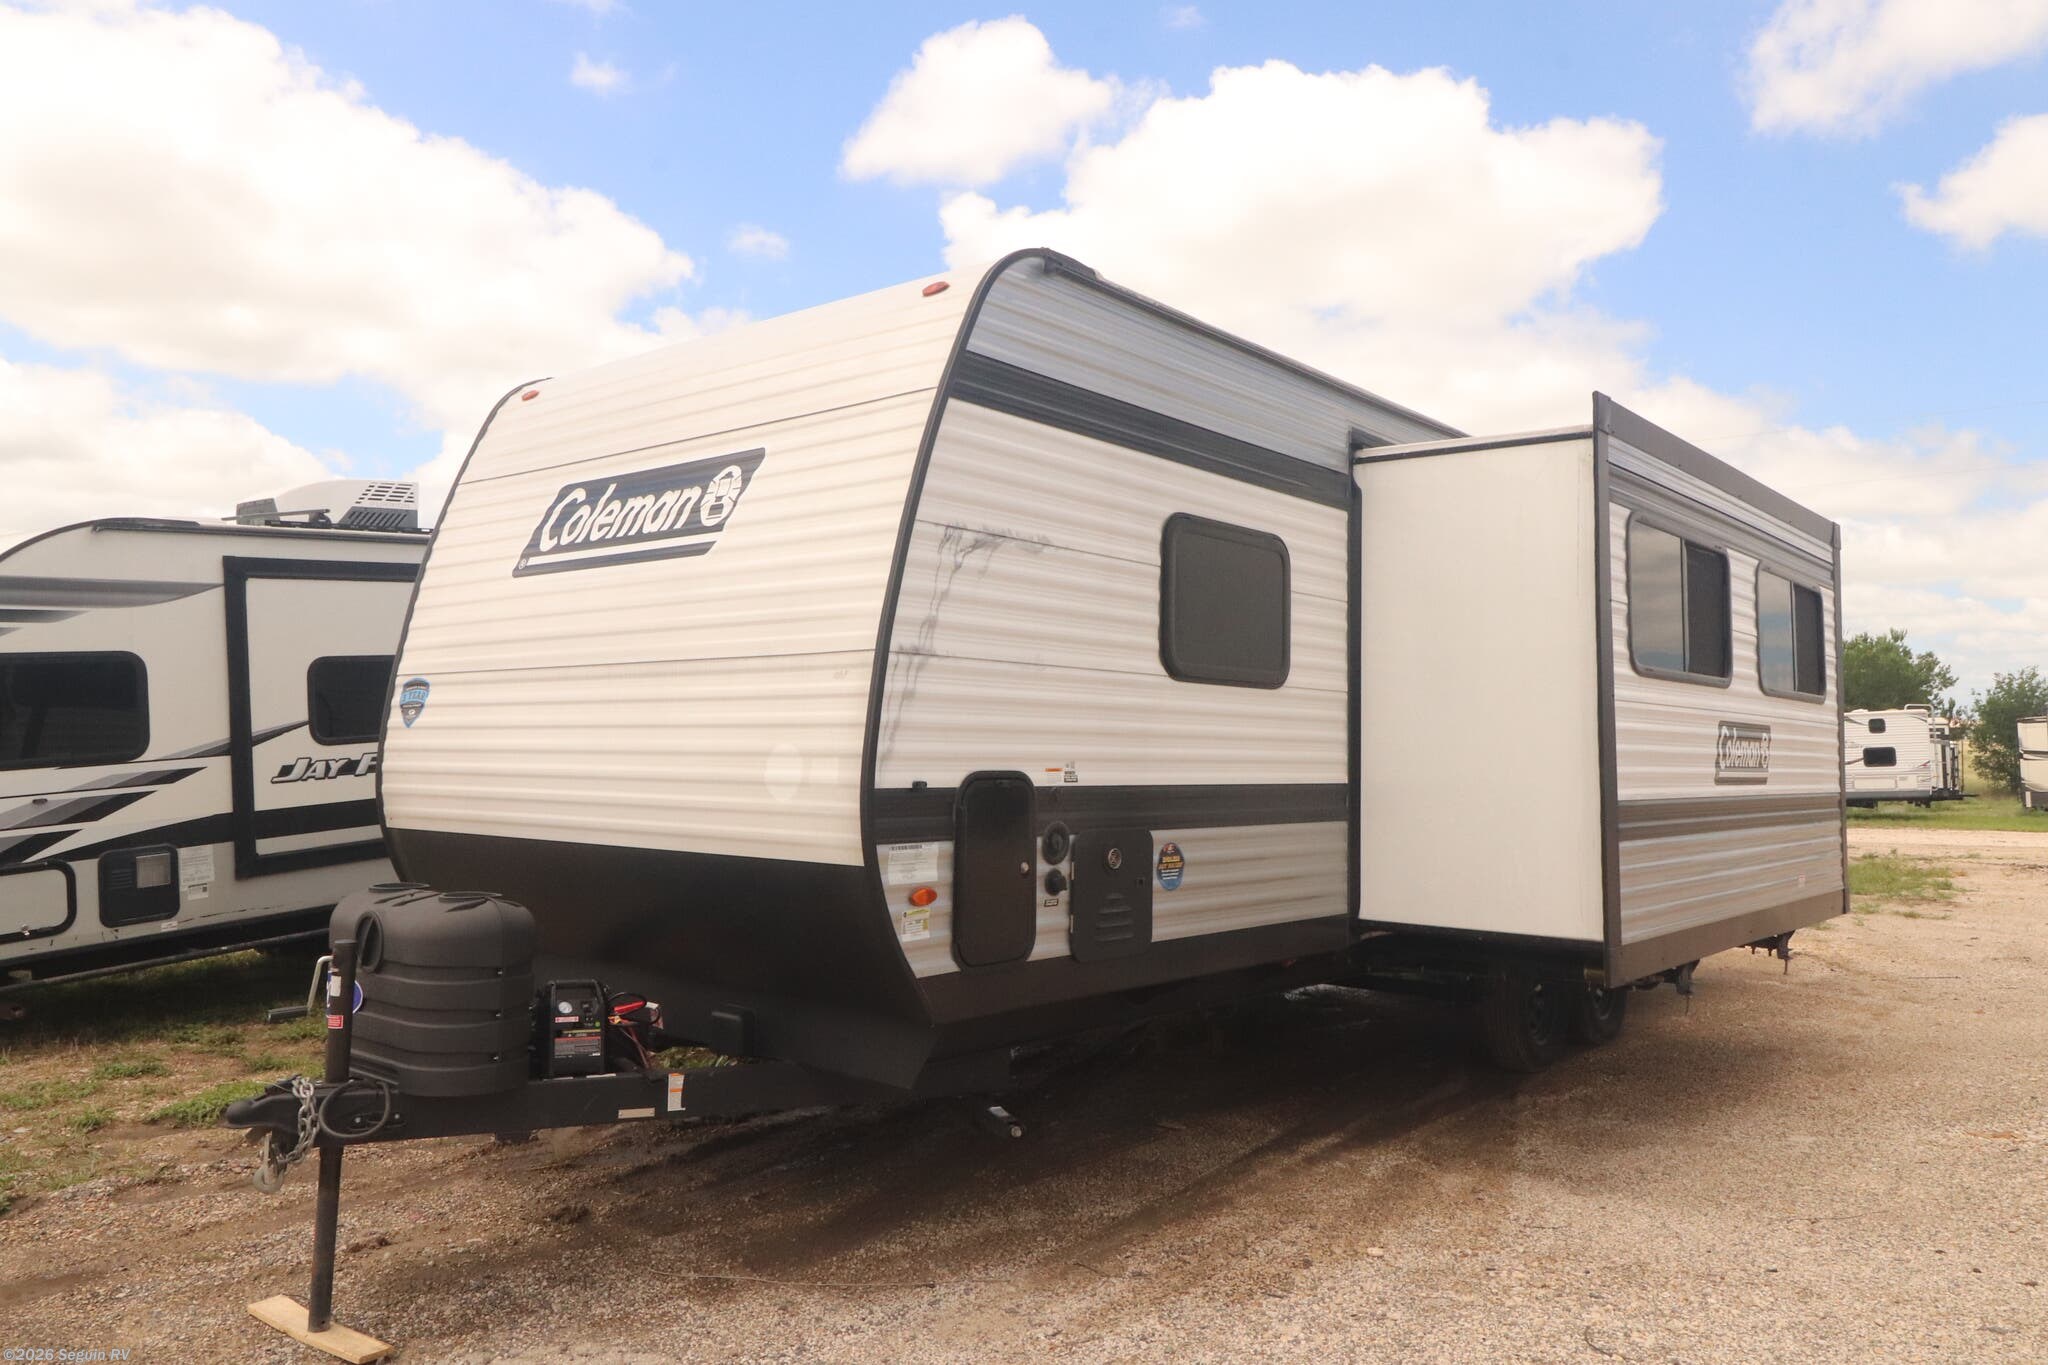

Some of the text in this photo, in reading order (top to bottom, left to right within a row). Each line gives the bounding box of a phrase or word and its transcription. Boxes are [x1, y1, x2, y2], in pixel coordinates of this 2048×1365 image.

[539, 483, 702, 552] Coleman
[1718, 725, 1761, 770] Coleman
[271, 757, 351, 784] JAY
